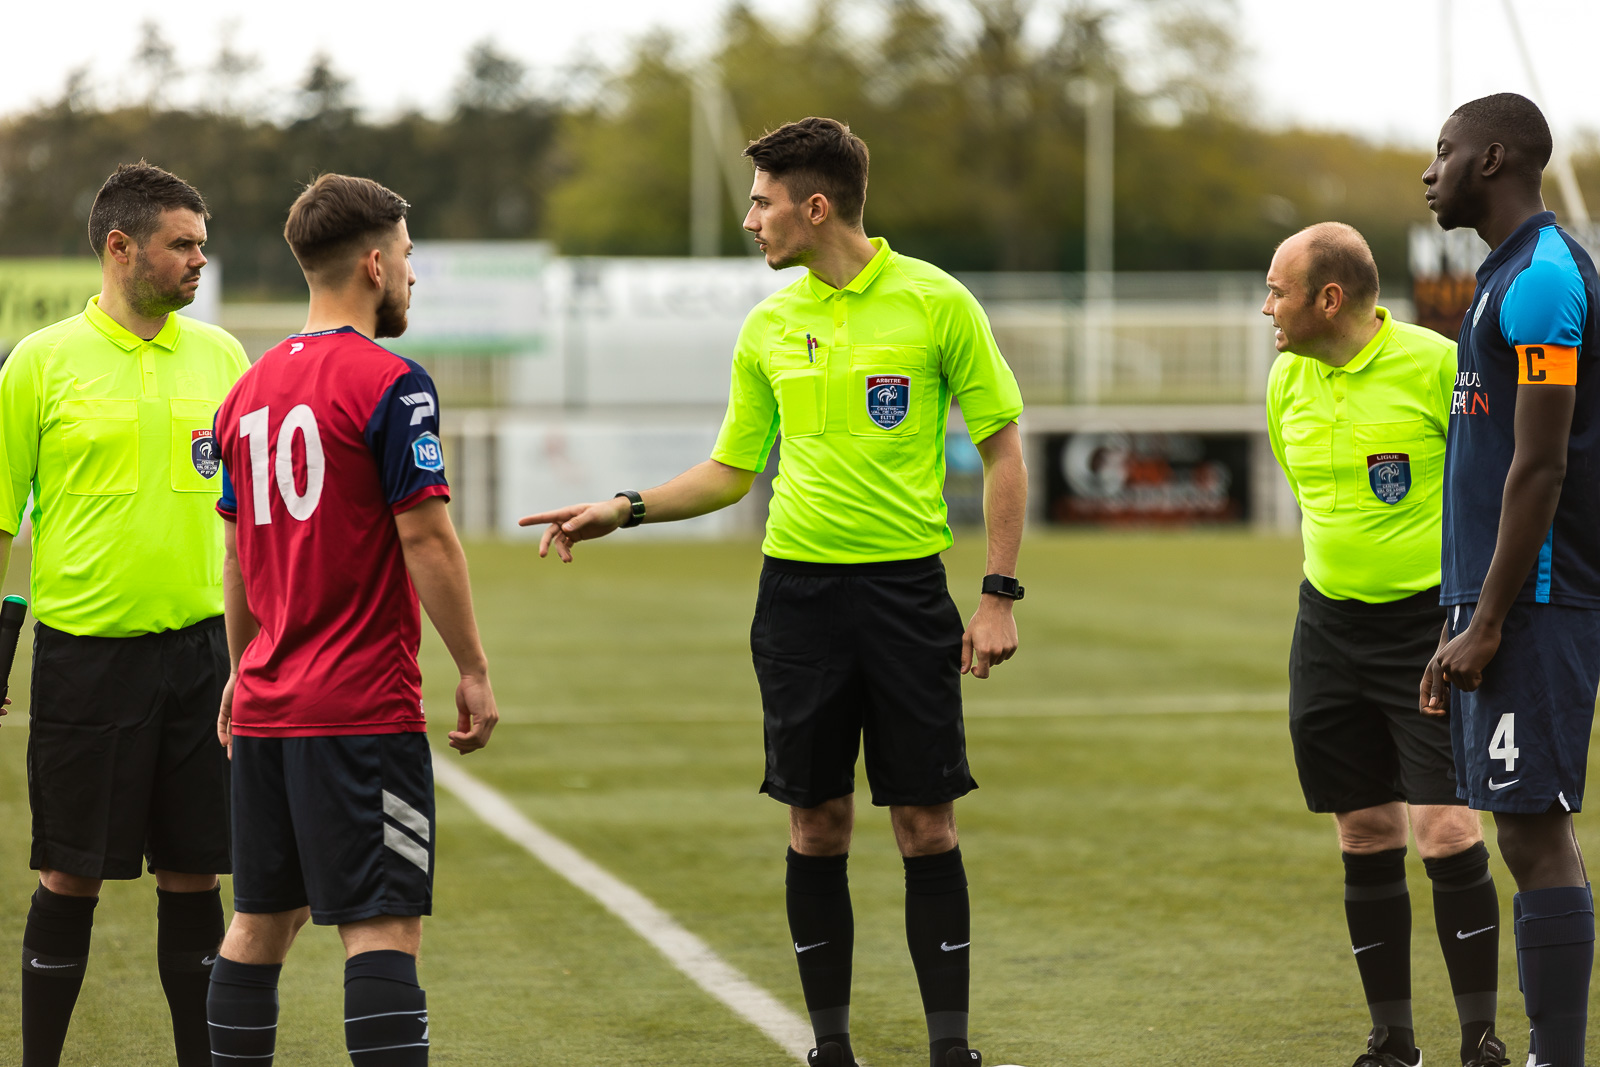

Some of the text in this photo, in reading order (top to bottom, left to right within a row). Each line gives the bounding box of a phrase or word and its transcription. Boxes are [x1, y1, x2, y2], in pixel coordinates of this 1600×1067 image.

[1525, 347, 1547, 382] C
[239, 404, 326, 526] 10
[417, 443, 438, 461] N3
[1488, 713, 1519, 772] 4
